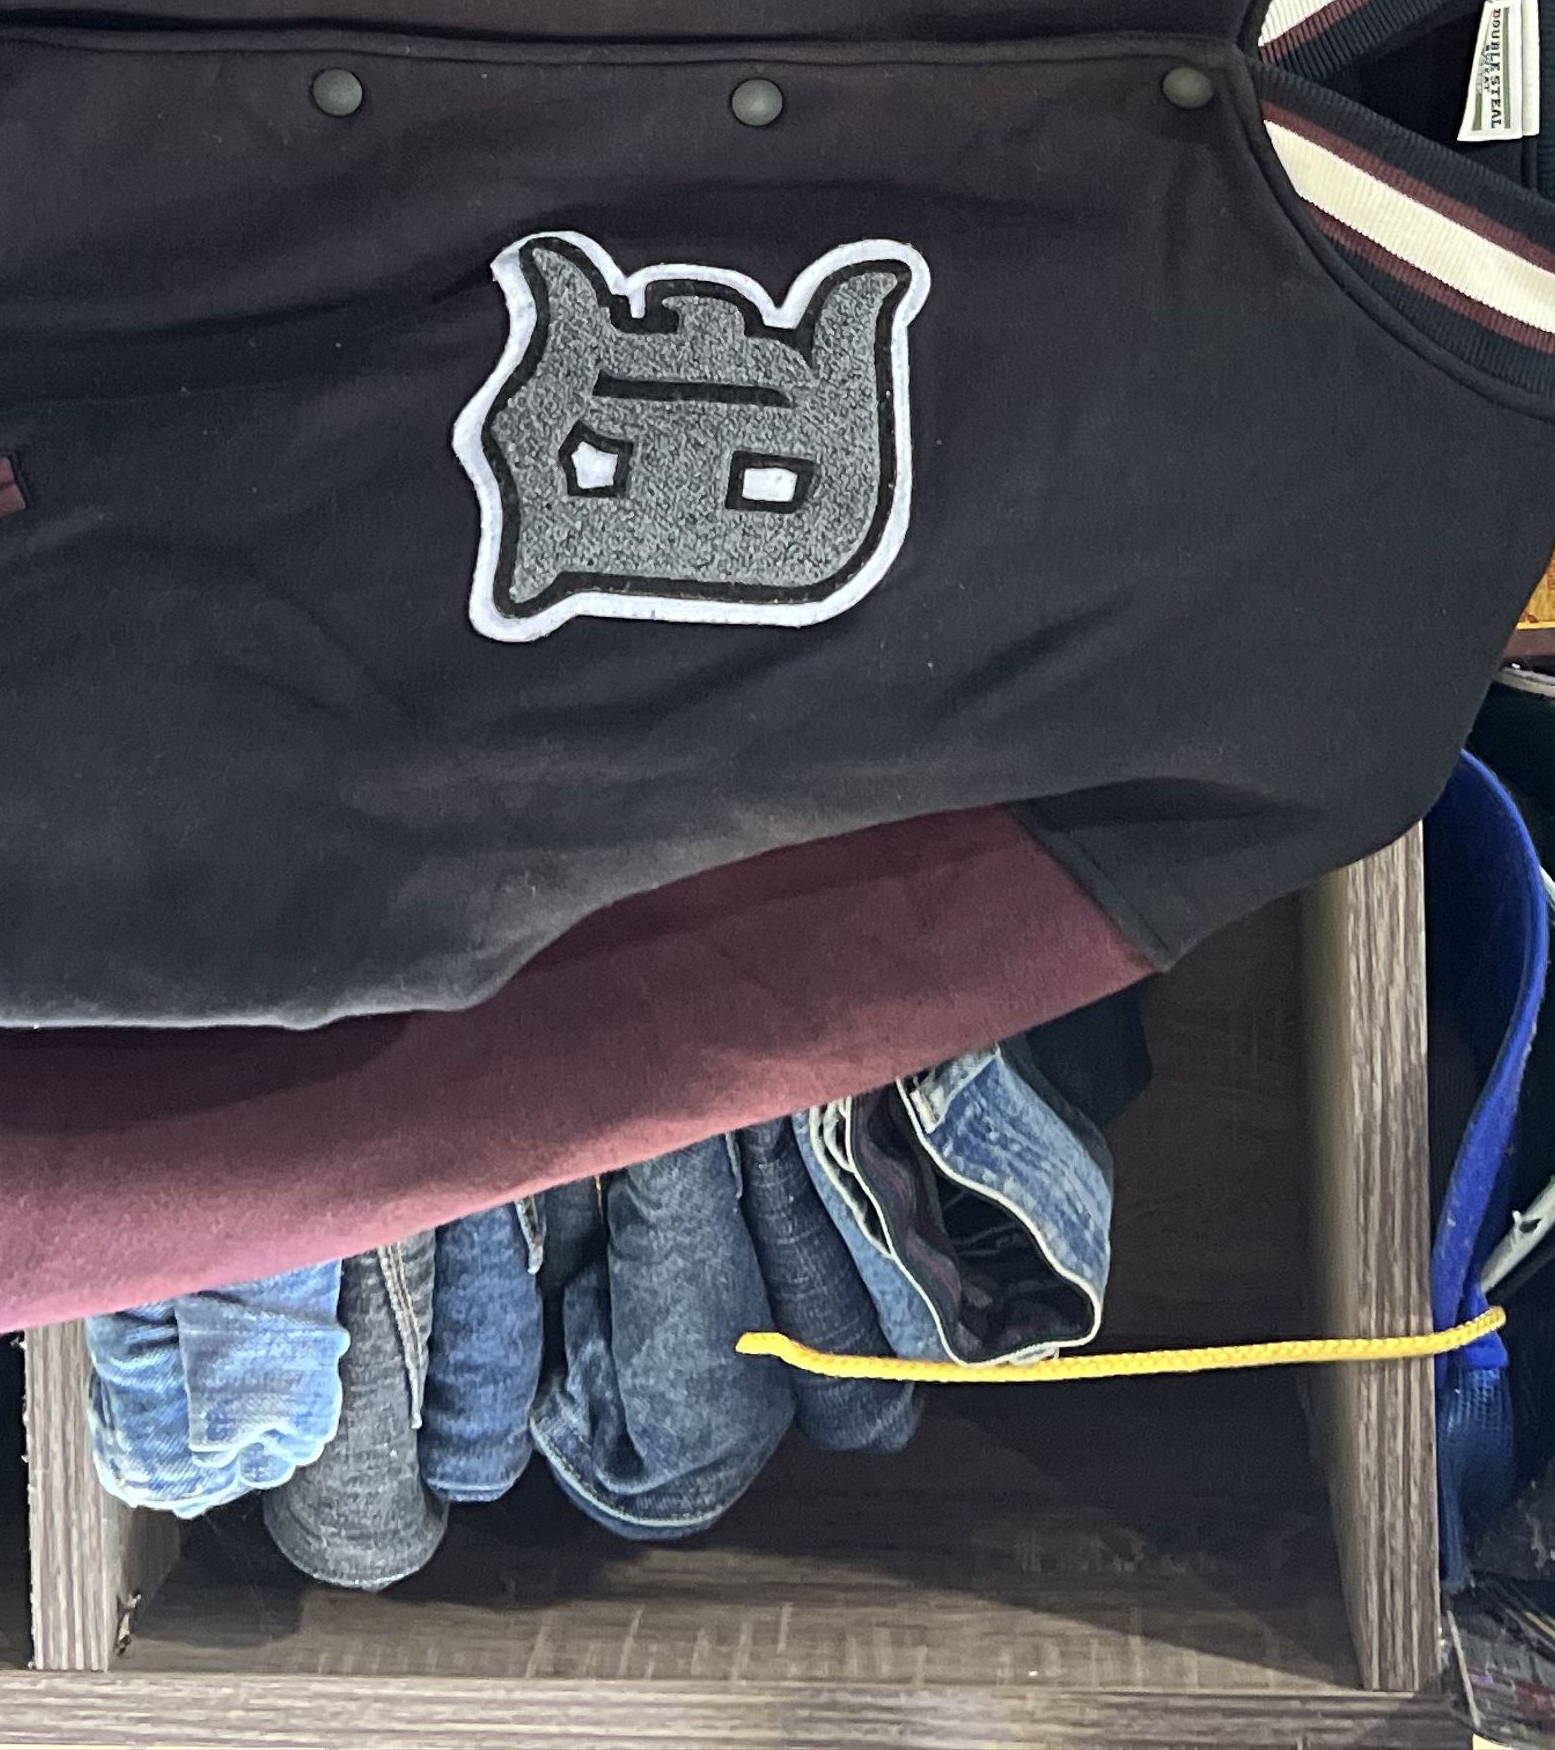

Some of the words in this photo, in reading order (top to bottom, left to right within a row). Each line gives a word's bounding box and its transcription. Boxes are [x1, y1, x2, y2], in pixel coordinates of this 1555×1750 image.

[1489, 8, 1502, 72] DOUBLE
[1490, 74, 1503, 129] STEAL
[454, 233, 929, 640] D
